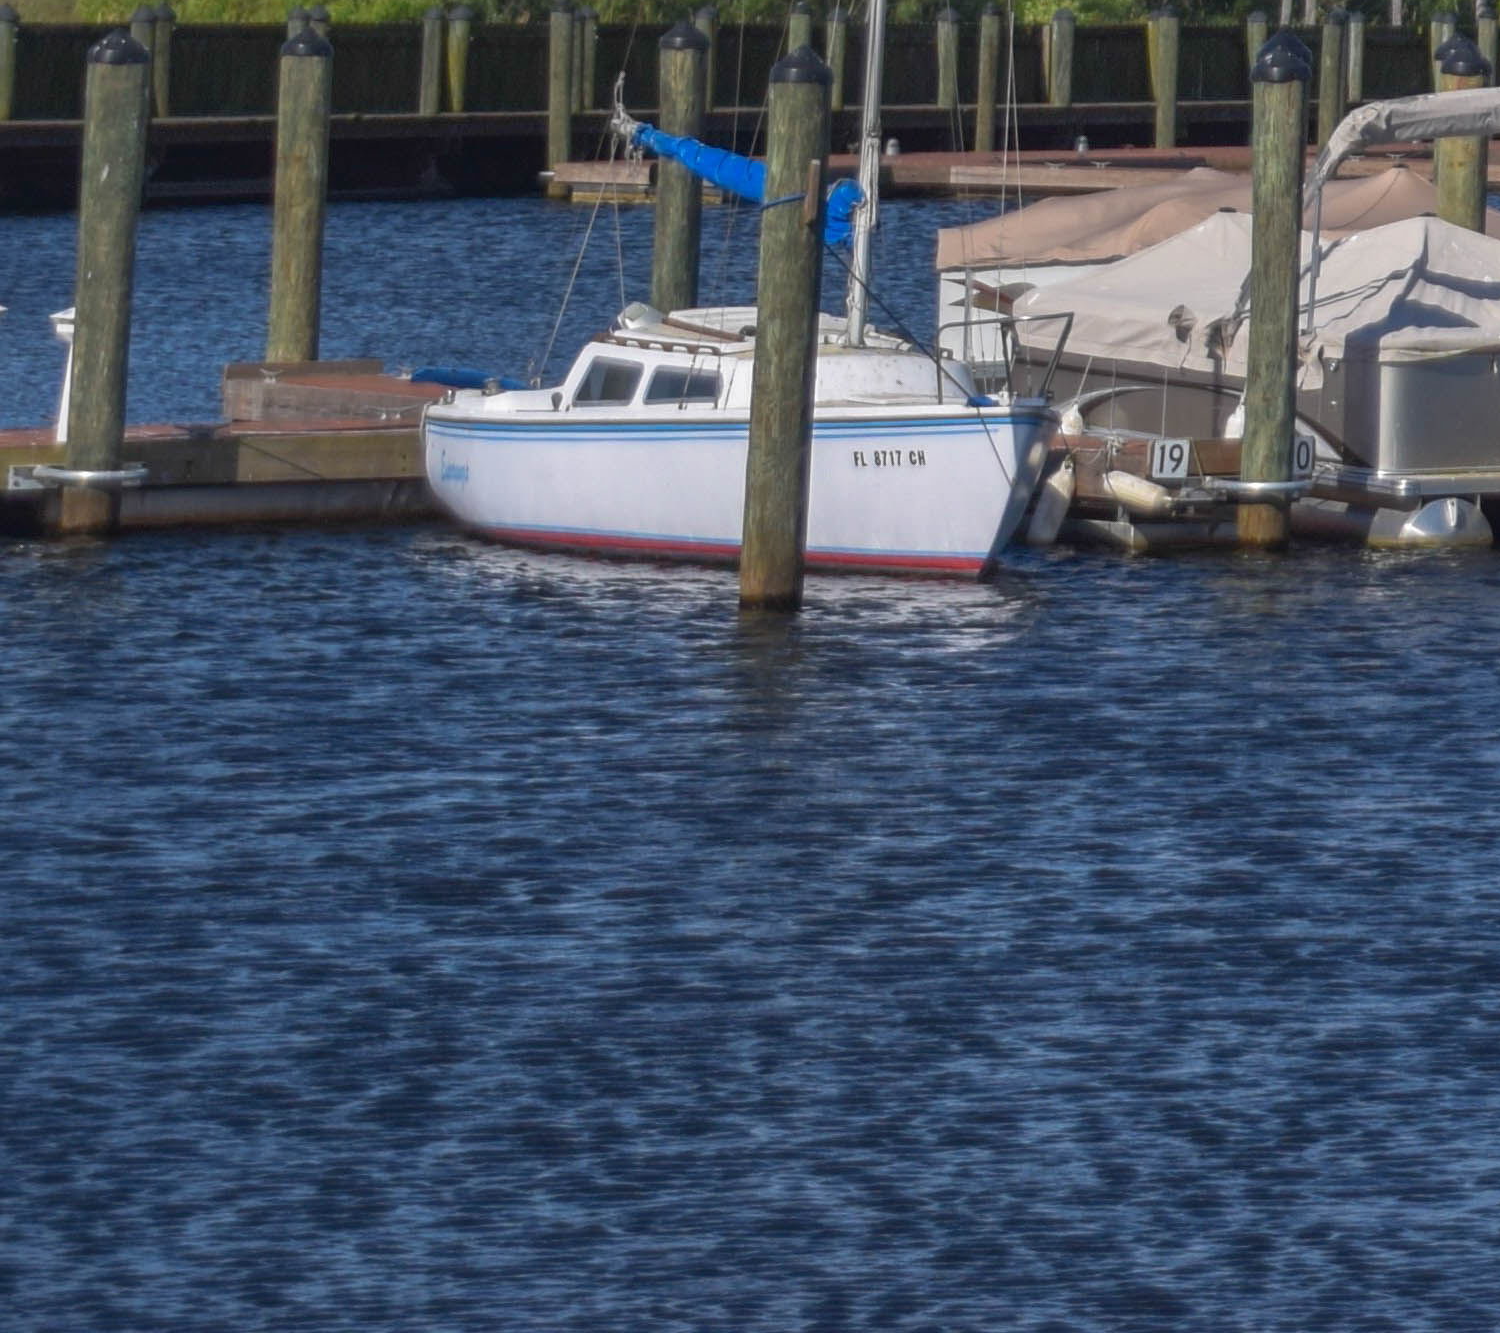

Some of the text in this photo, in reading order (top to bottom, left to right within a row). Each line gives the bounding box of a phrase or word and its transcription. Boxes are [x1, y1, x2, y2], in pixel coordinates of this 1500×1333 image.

[853, 450, 926, 467] FL 8717 CH
[1159, 443, 1184, 473] 19
